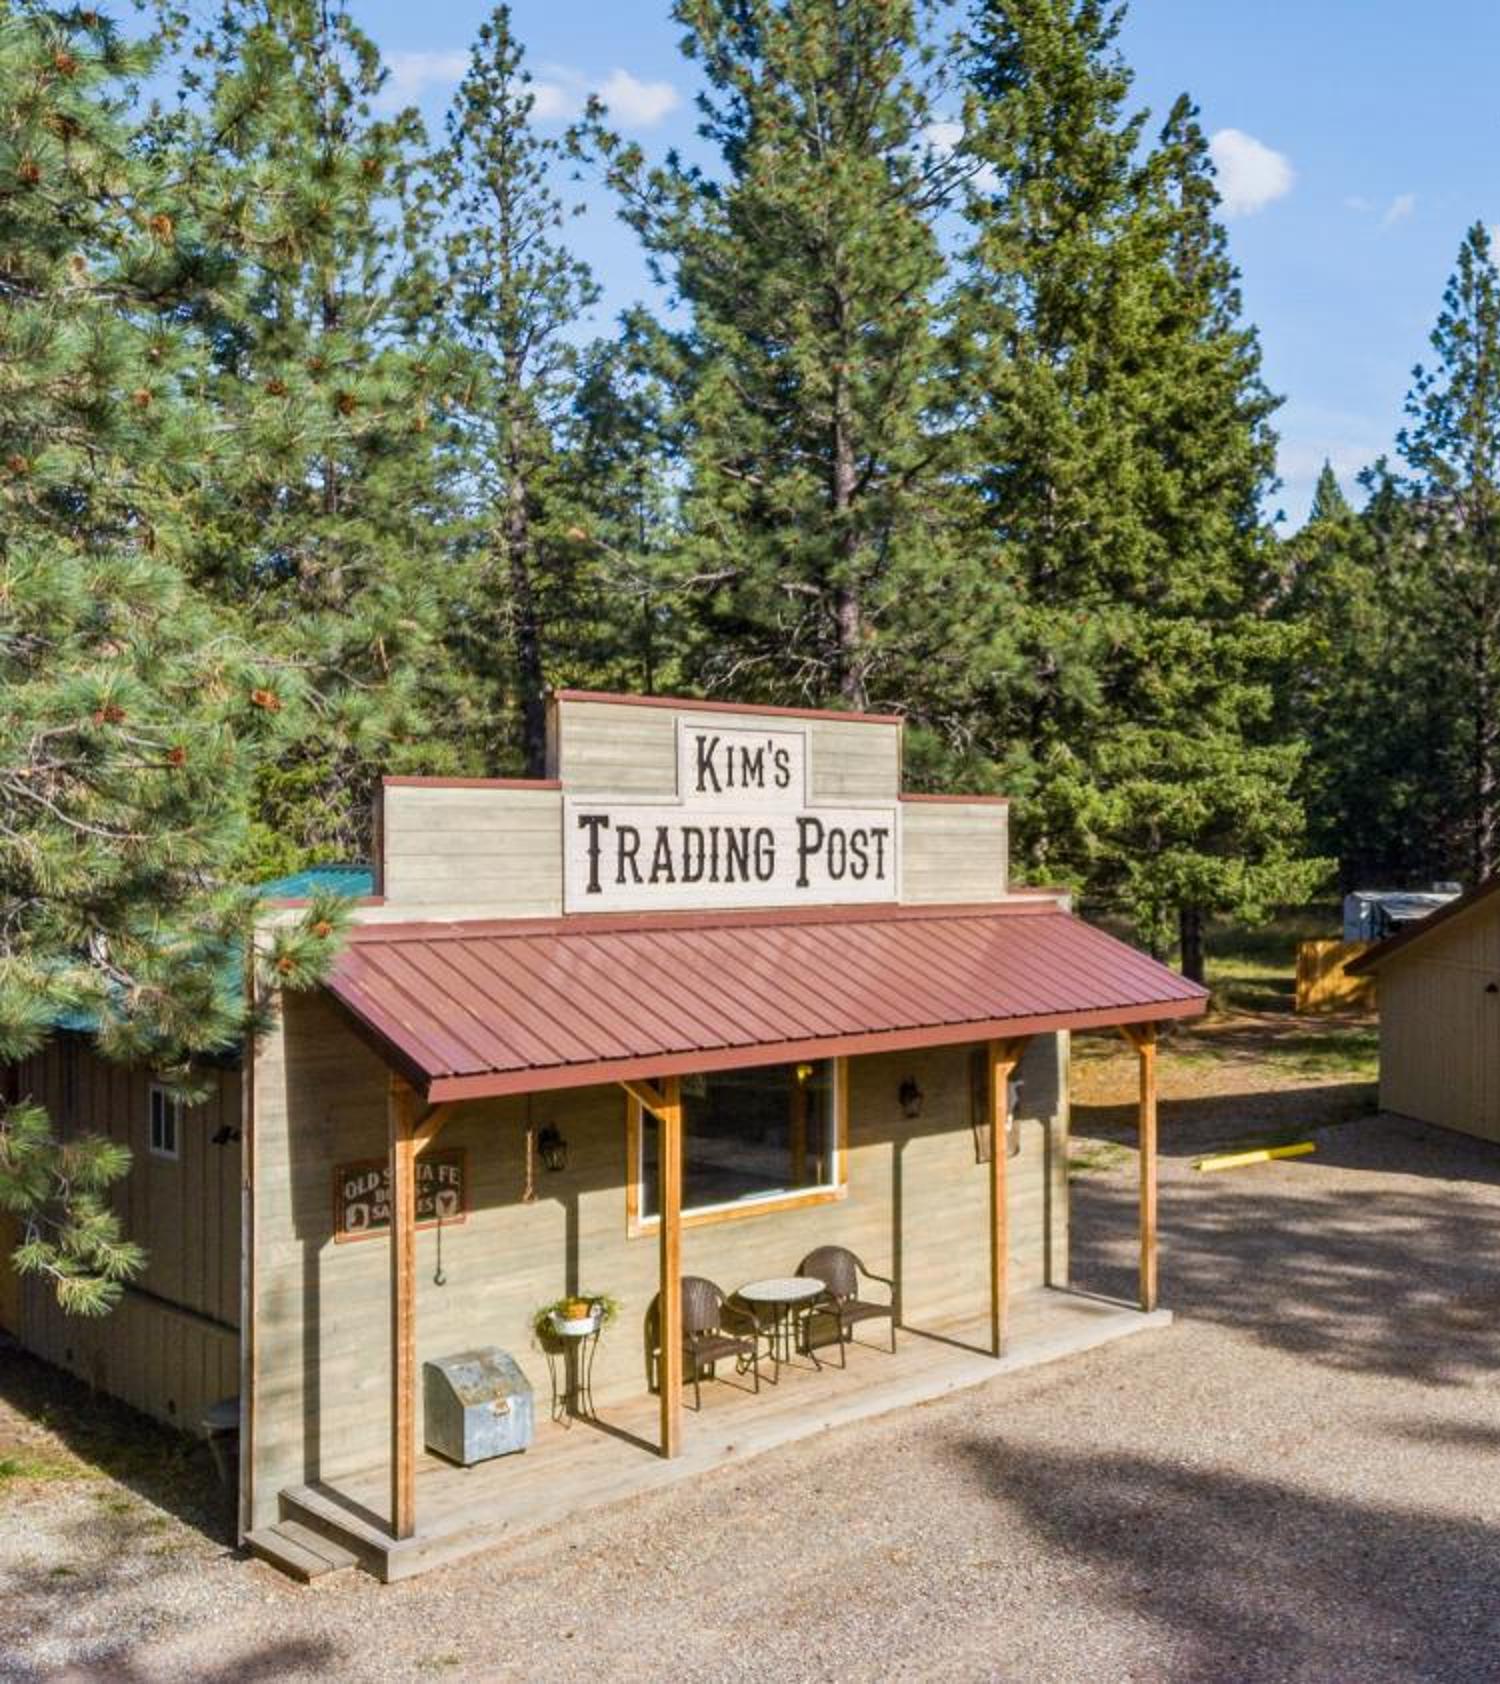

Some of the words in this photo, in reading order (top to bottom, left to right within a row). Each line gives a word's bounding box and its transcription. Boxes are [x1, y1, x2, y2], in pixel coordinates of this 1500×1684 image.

[695, 734, 791, 793] KIM'S
[578, 814, 775, 894] TRADING
[795, 816, 889, 888] POST
[345, 1172, 380, 1200] OLD
[438, 1164, 460, 1185] FE
